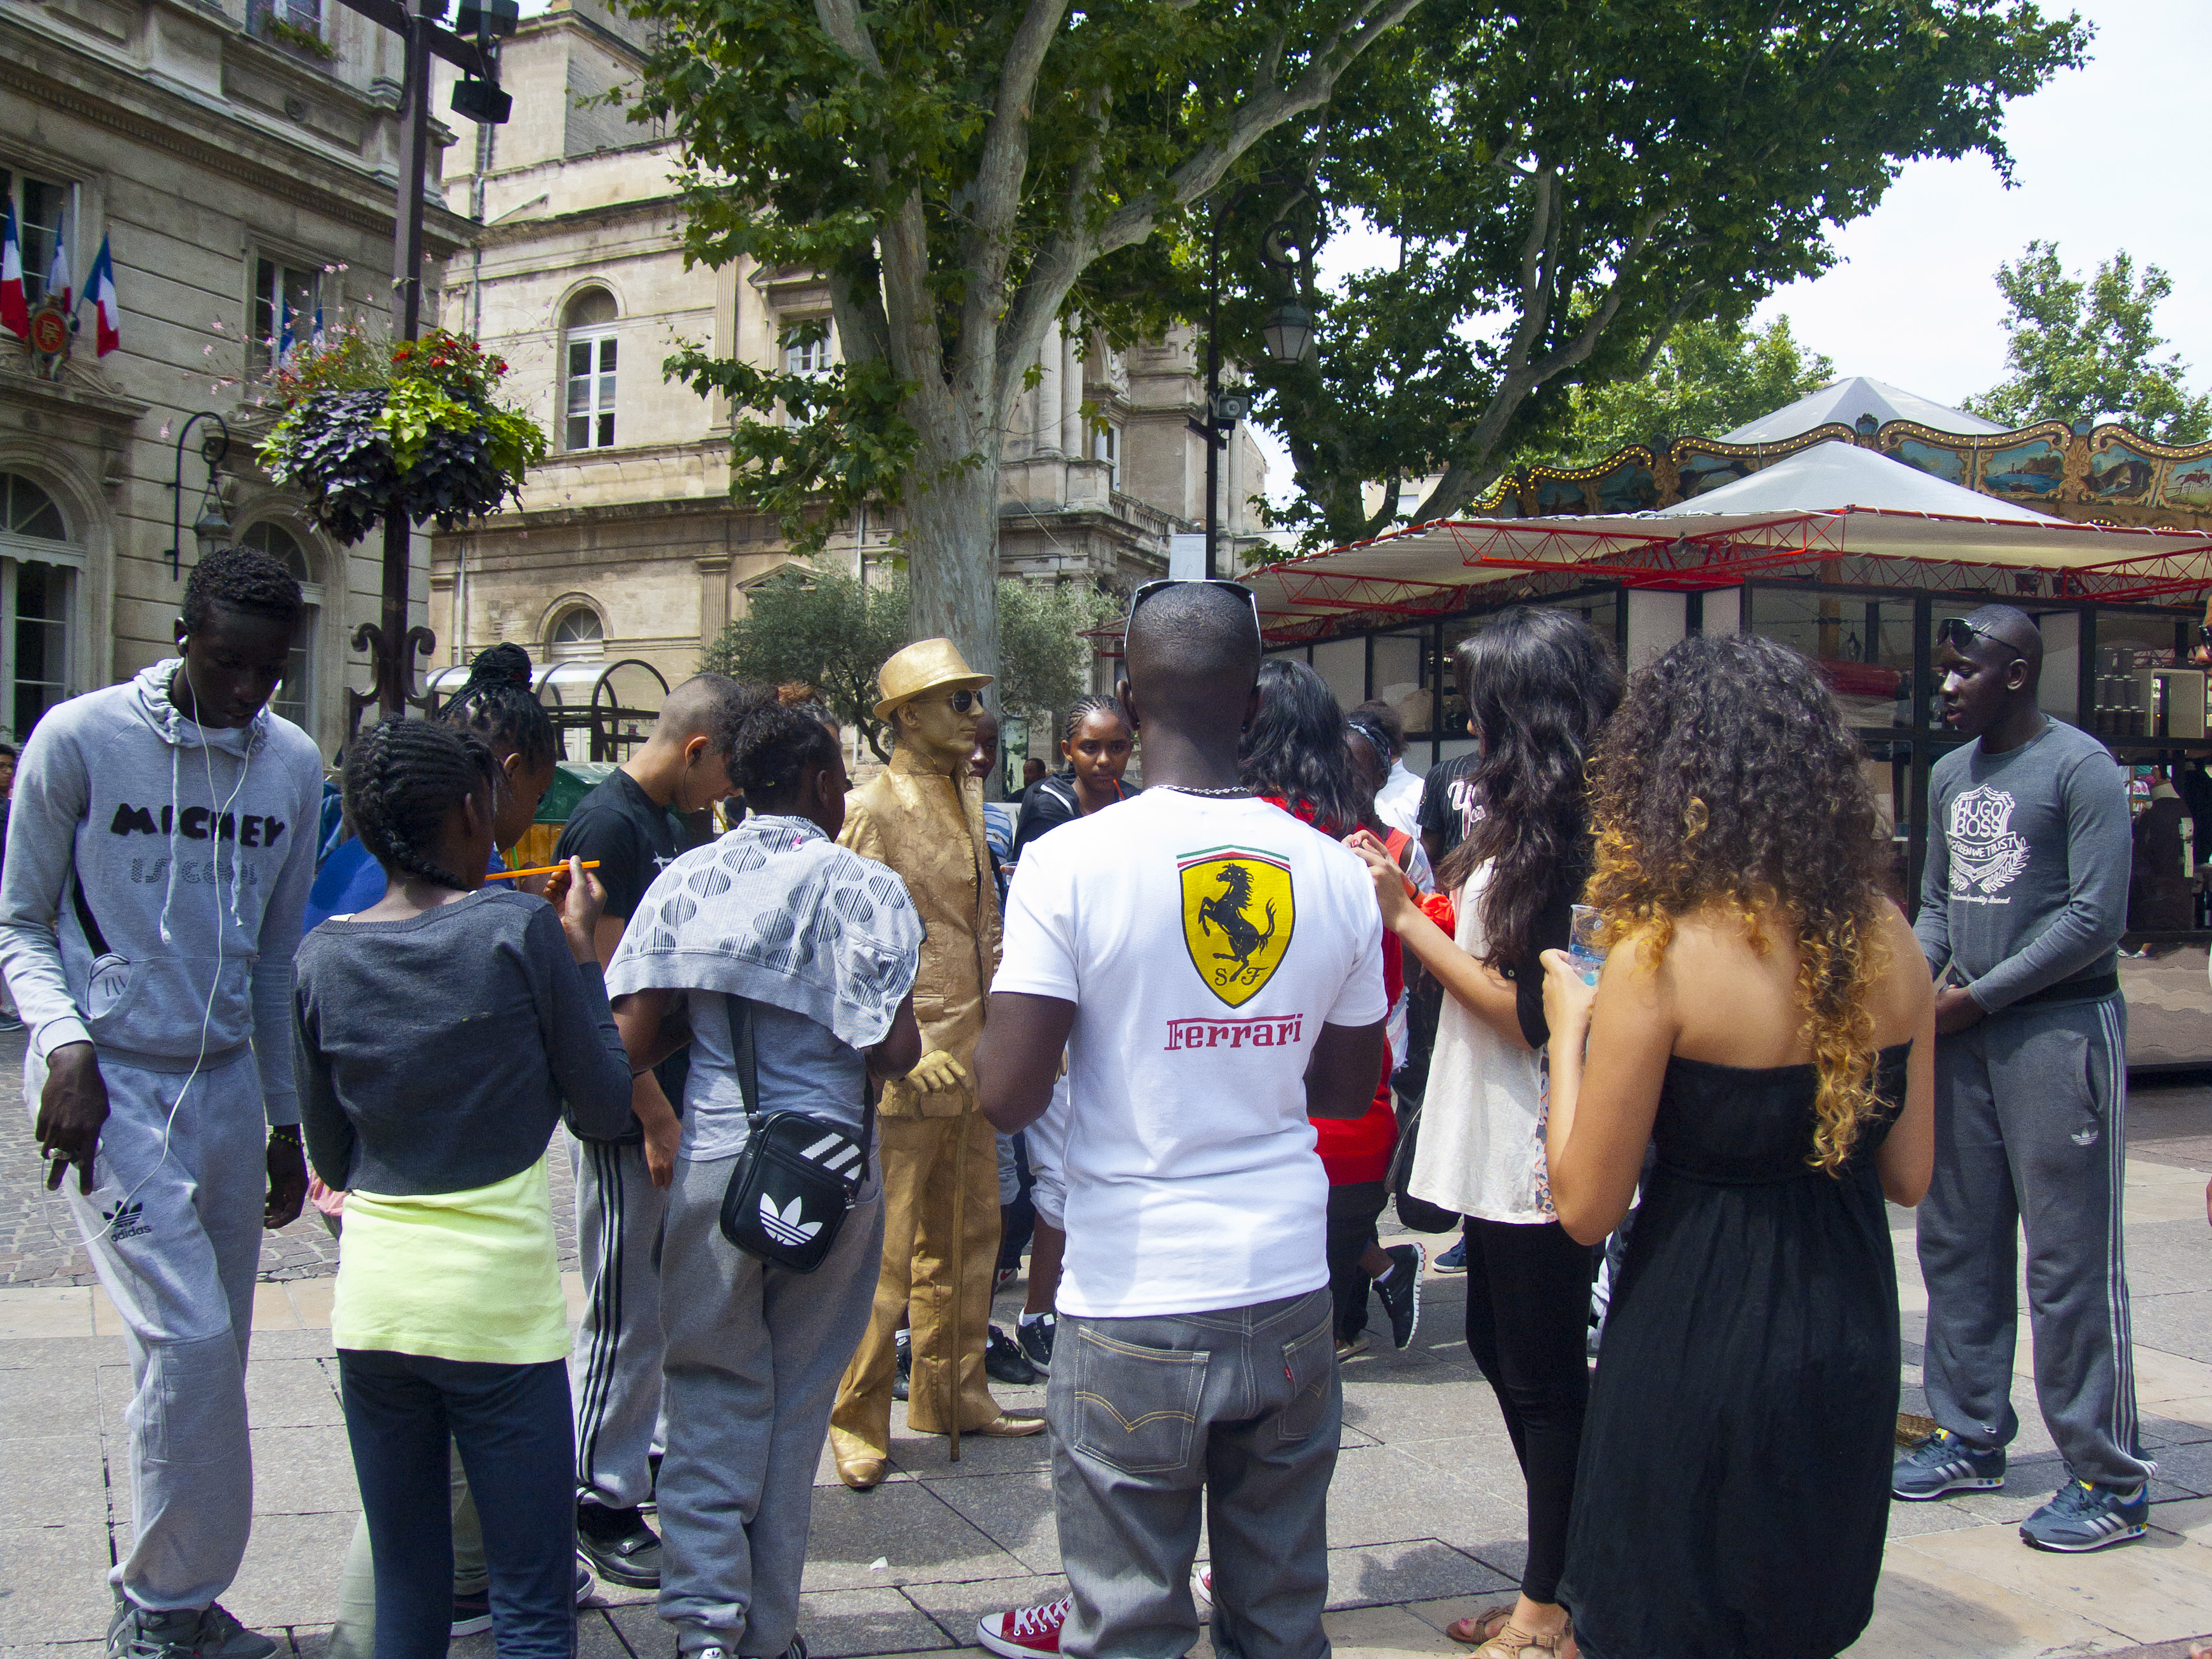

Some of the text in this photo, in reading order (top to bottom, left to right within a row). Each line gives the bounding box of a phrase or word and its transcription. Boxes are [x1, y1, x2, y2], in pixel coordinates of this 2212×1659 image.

[1956, 800, 2003, 818] HUGO
[110, 803, 285, 847] MICKEY
[1956, 817, 2000, 838] BOSS
[1972, 847, 1986, 857] WE
[1985, 837, 2015, 857] TRUST
[1214, 966, 1269, 986] S F
[1164, 1013, 1303, 1050] Ferrari
[110, 1225, 152, 1242] adidas
